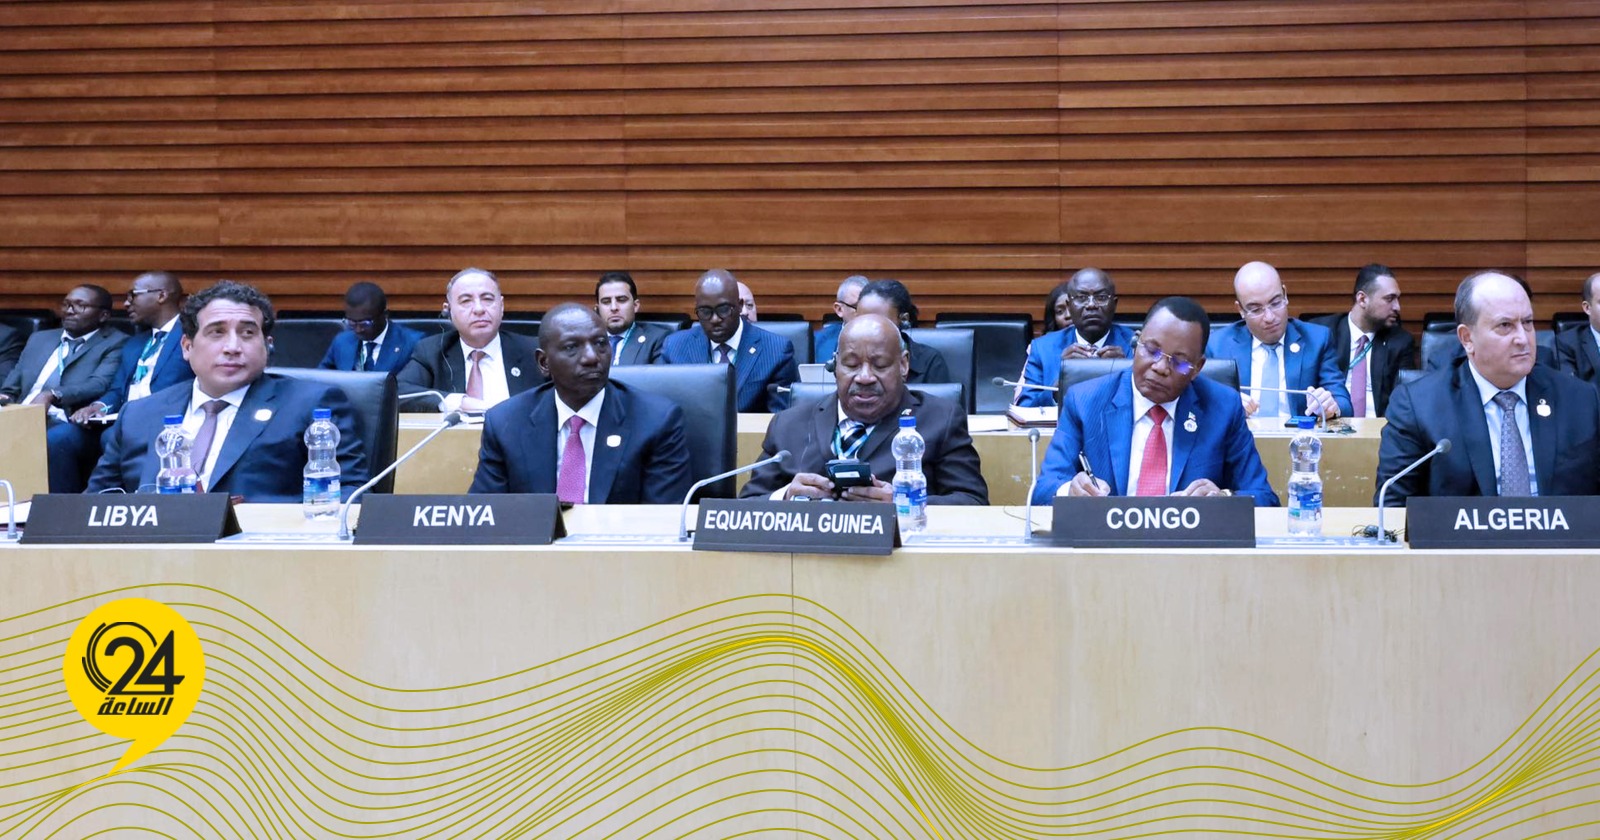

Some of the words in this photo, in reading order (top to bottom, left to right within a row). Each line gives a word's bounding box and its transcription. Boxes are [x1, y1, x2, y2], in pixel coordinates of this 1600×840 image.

[87, 505, 159, 527] LIBYA
[412, 505, 496, 527] KENYA
[704, 510, 813, 532] EQUATORIAL
[817, 512, 884, 535] GUINEA
[1106, 507, 1201, 530] CONGO
[1453, 507, 1570, 531] ALGERIA
